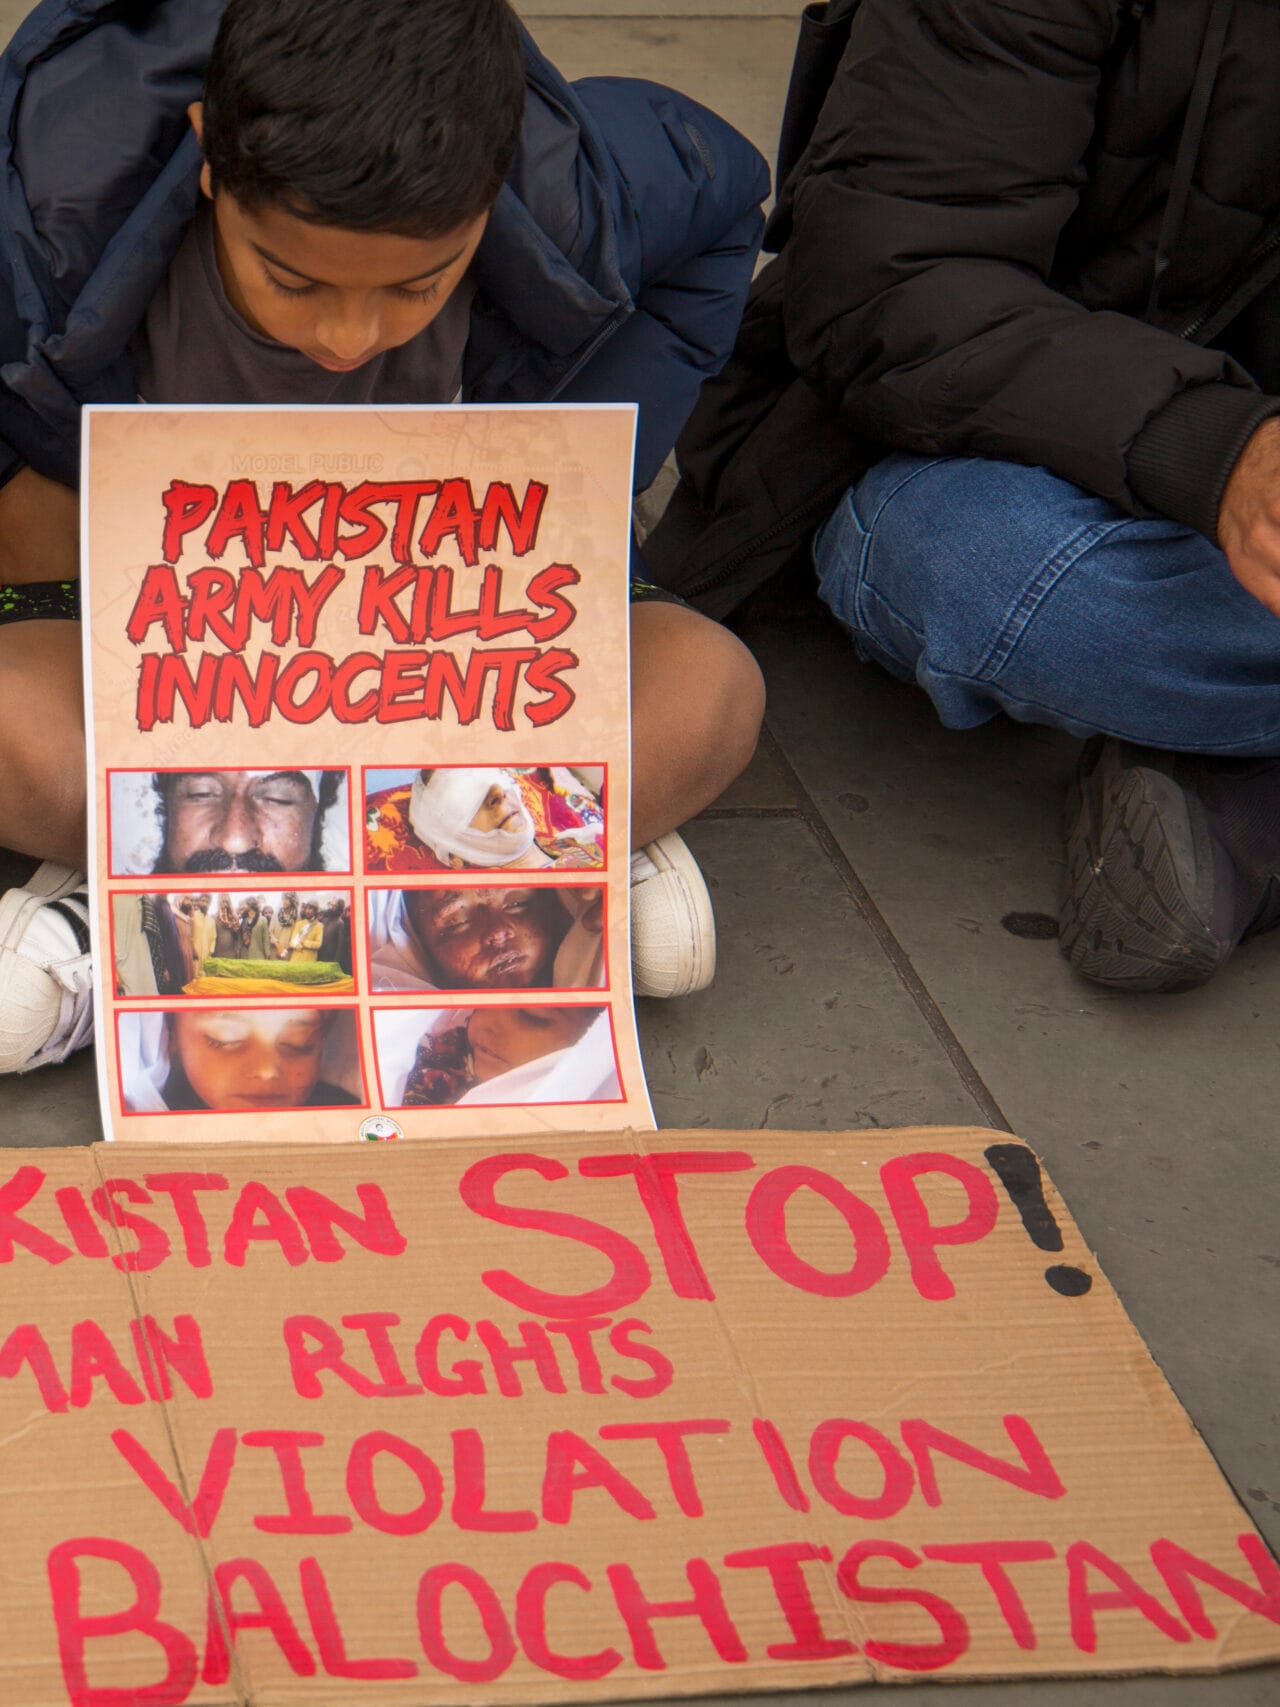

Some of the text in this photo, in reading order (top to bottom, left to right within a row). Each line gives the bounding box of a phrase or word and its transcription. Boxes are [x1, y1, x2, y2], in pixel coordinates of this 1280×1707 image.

[162, 478, 548, 567] PAKISTAN
[126, 562, 581, 653] ARMY KILLS
[135, 647, 580, 731] INNOCENTS
[283, 1312, 674, 1399] RIGHTS
[111, 1414, 1067, 1538] VIOLATION
[47, 1533, 1280, 1707] BALOCHISTAN
